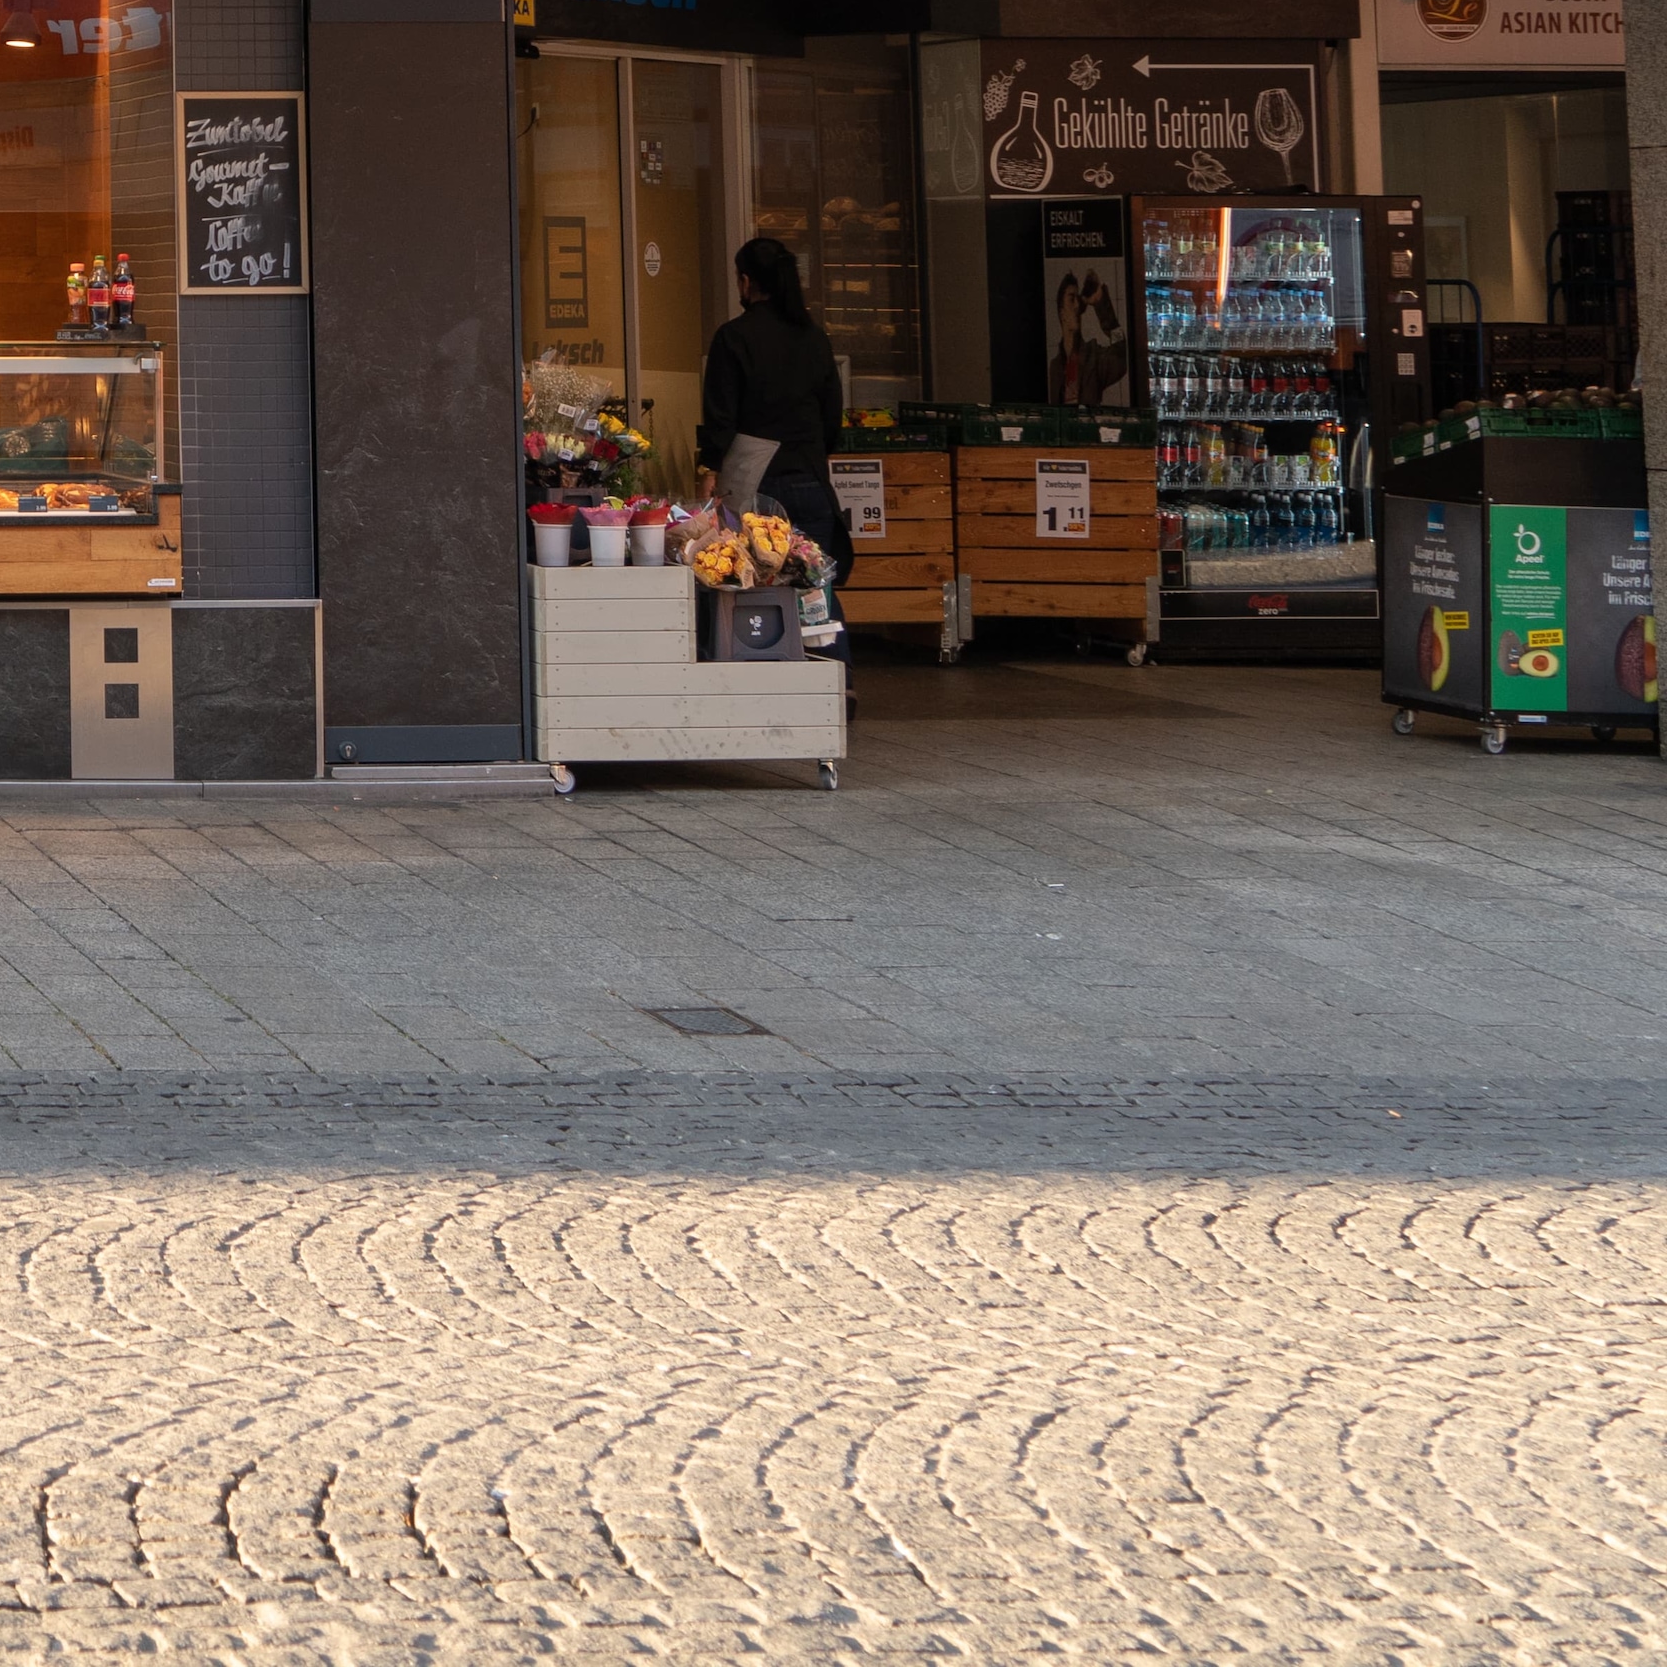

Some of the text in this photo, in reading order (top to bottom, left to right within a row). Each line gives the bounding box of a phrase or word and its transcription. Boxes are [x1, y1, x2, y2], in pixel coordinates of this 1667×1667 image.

[1500, 12, 1561, 34] ASIAN
[1053, 97, 1249, 148] Gekühlte Getränke
[1050, 210, 1083, 226] EISKALT
[1051, 231, 1106, 248] ERFRISCHEN.
[200, 254, 235, 282] to
[549, 304, 585, 319] EDEKA
[1045, 481, 1081, 490] Zwetschgen
[1515, 554, 1543, 564] Apeel
[1612, 555, 1647, 573] Länger
[1603, 572, 1642, 588] Unsere
[1609, 591, 1621, 605] im
